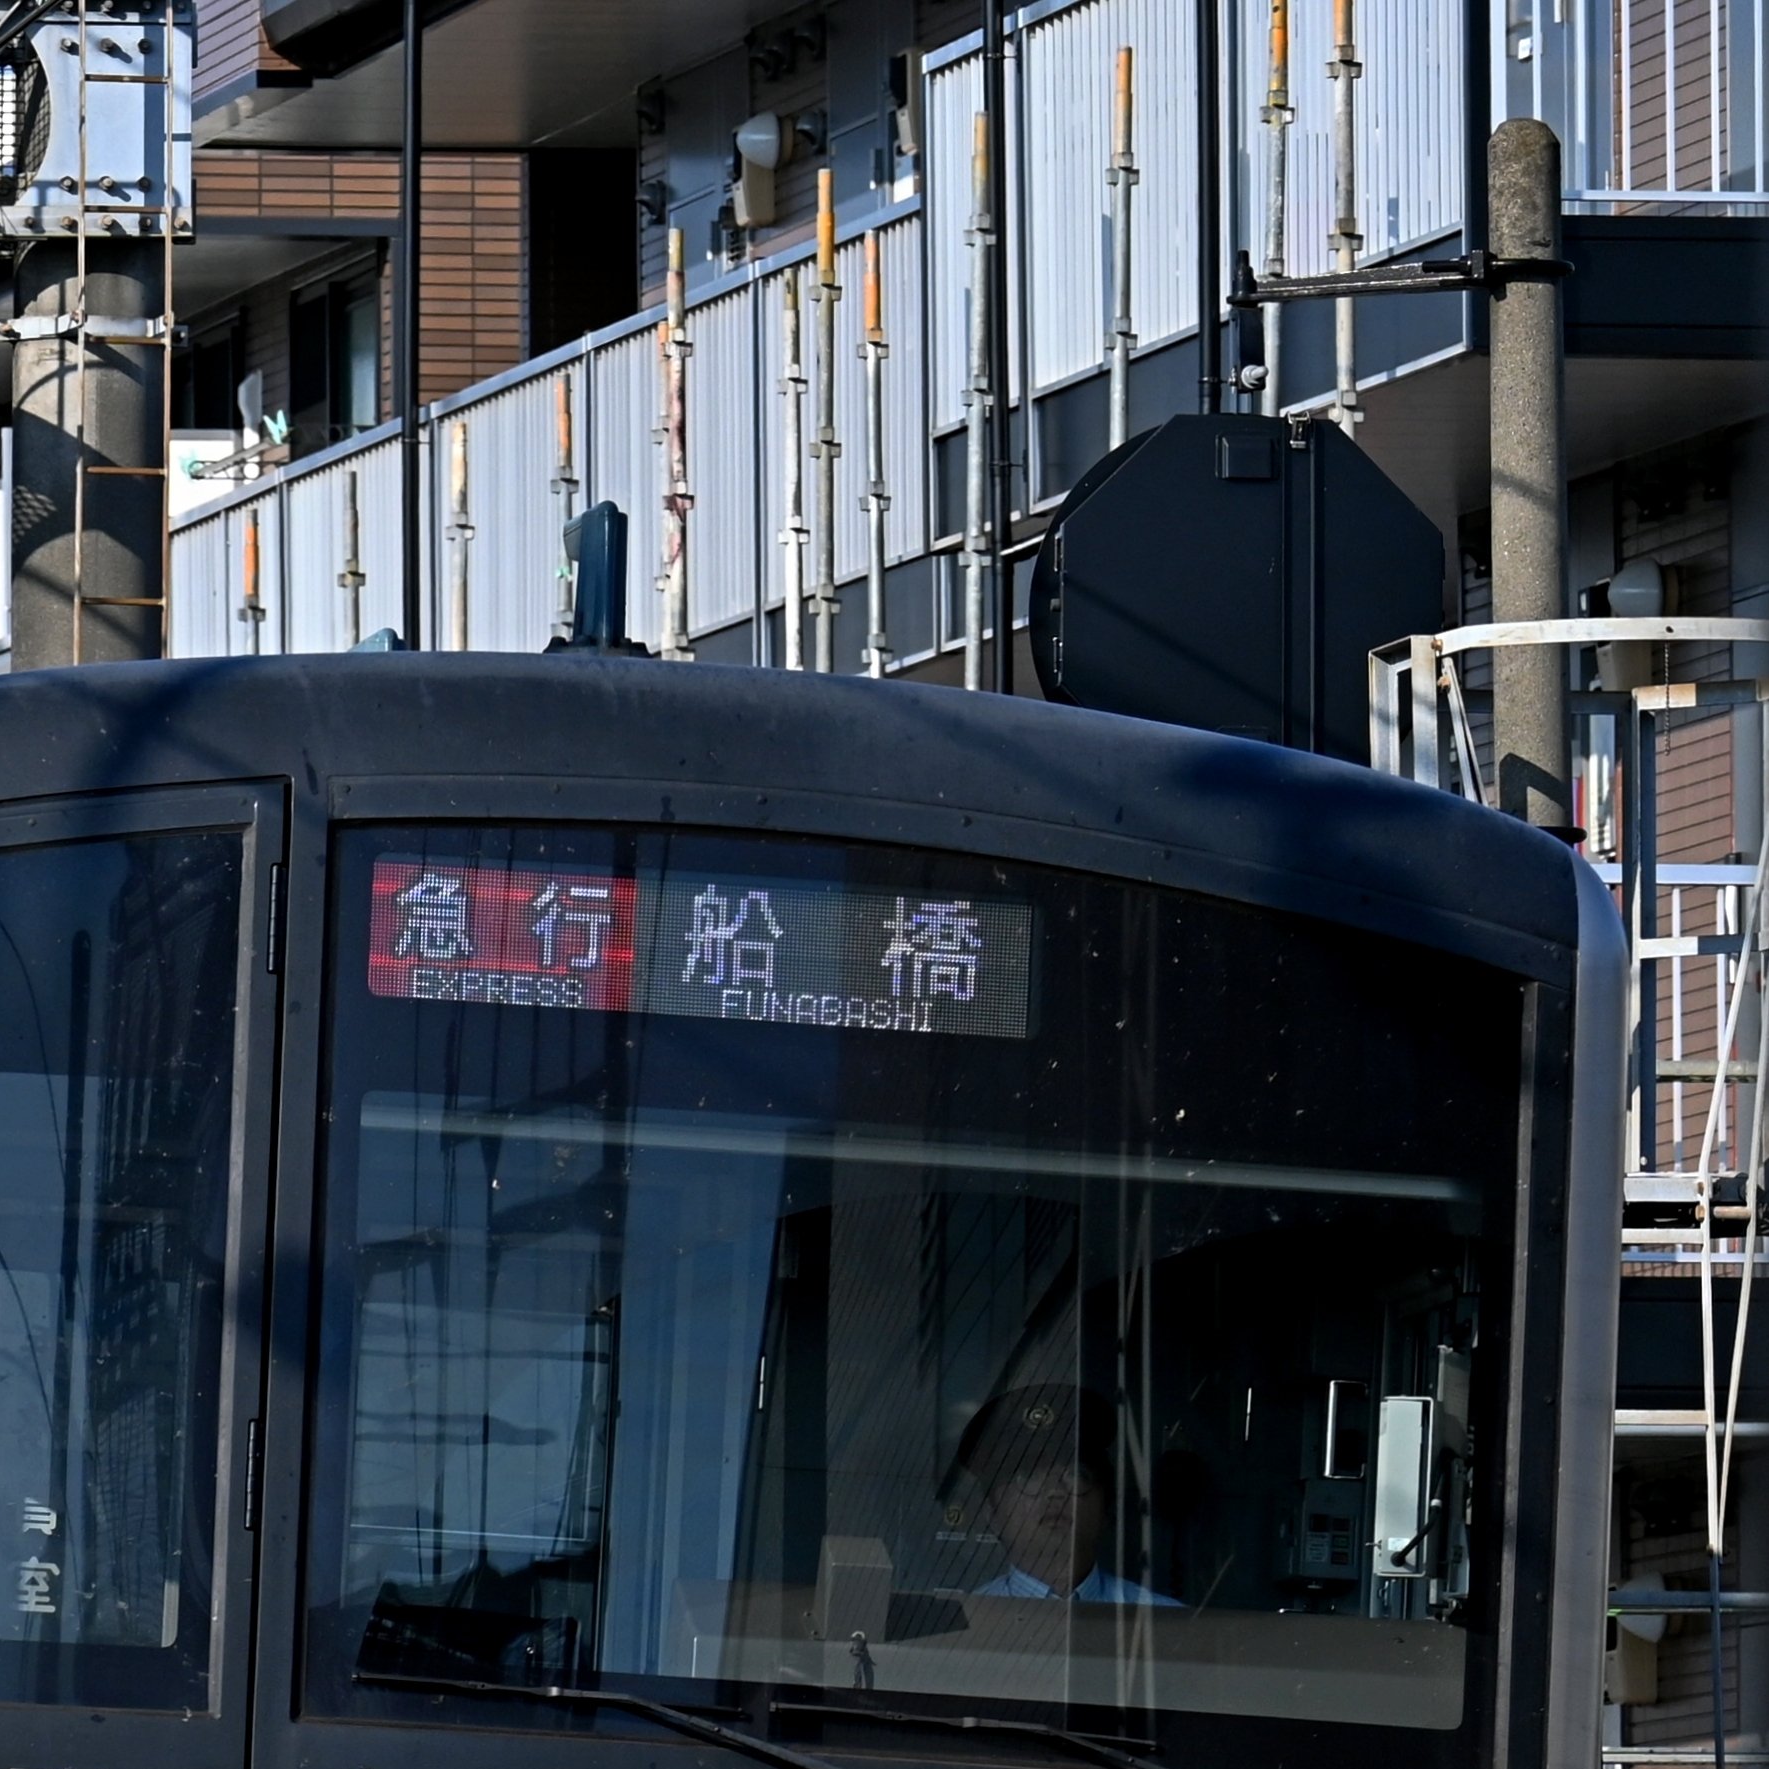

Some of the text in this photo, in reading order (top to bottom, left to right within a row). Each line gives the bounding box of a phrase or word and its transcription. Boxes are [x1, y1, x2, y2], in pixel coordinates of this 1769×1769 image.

[394, 873, 611, 970] 急行
[681, 884, 981, 1001] 船橋
[411, 969, 584, 1009] EXPRESS
[721, 989, 933, 1033] FUNABASHI
